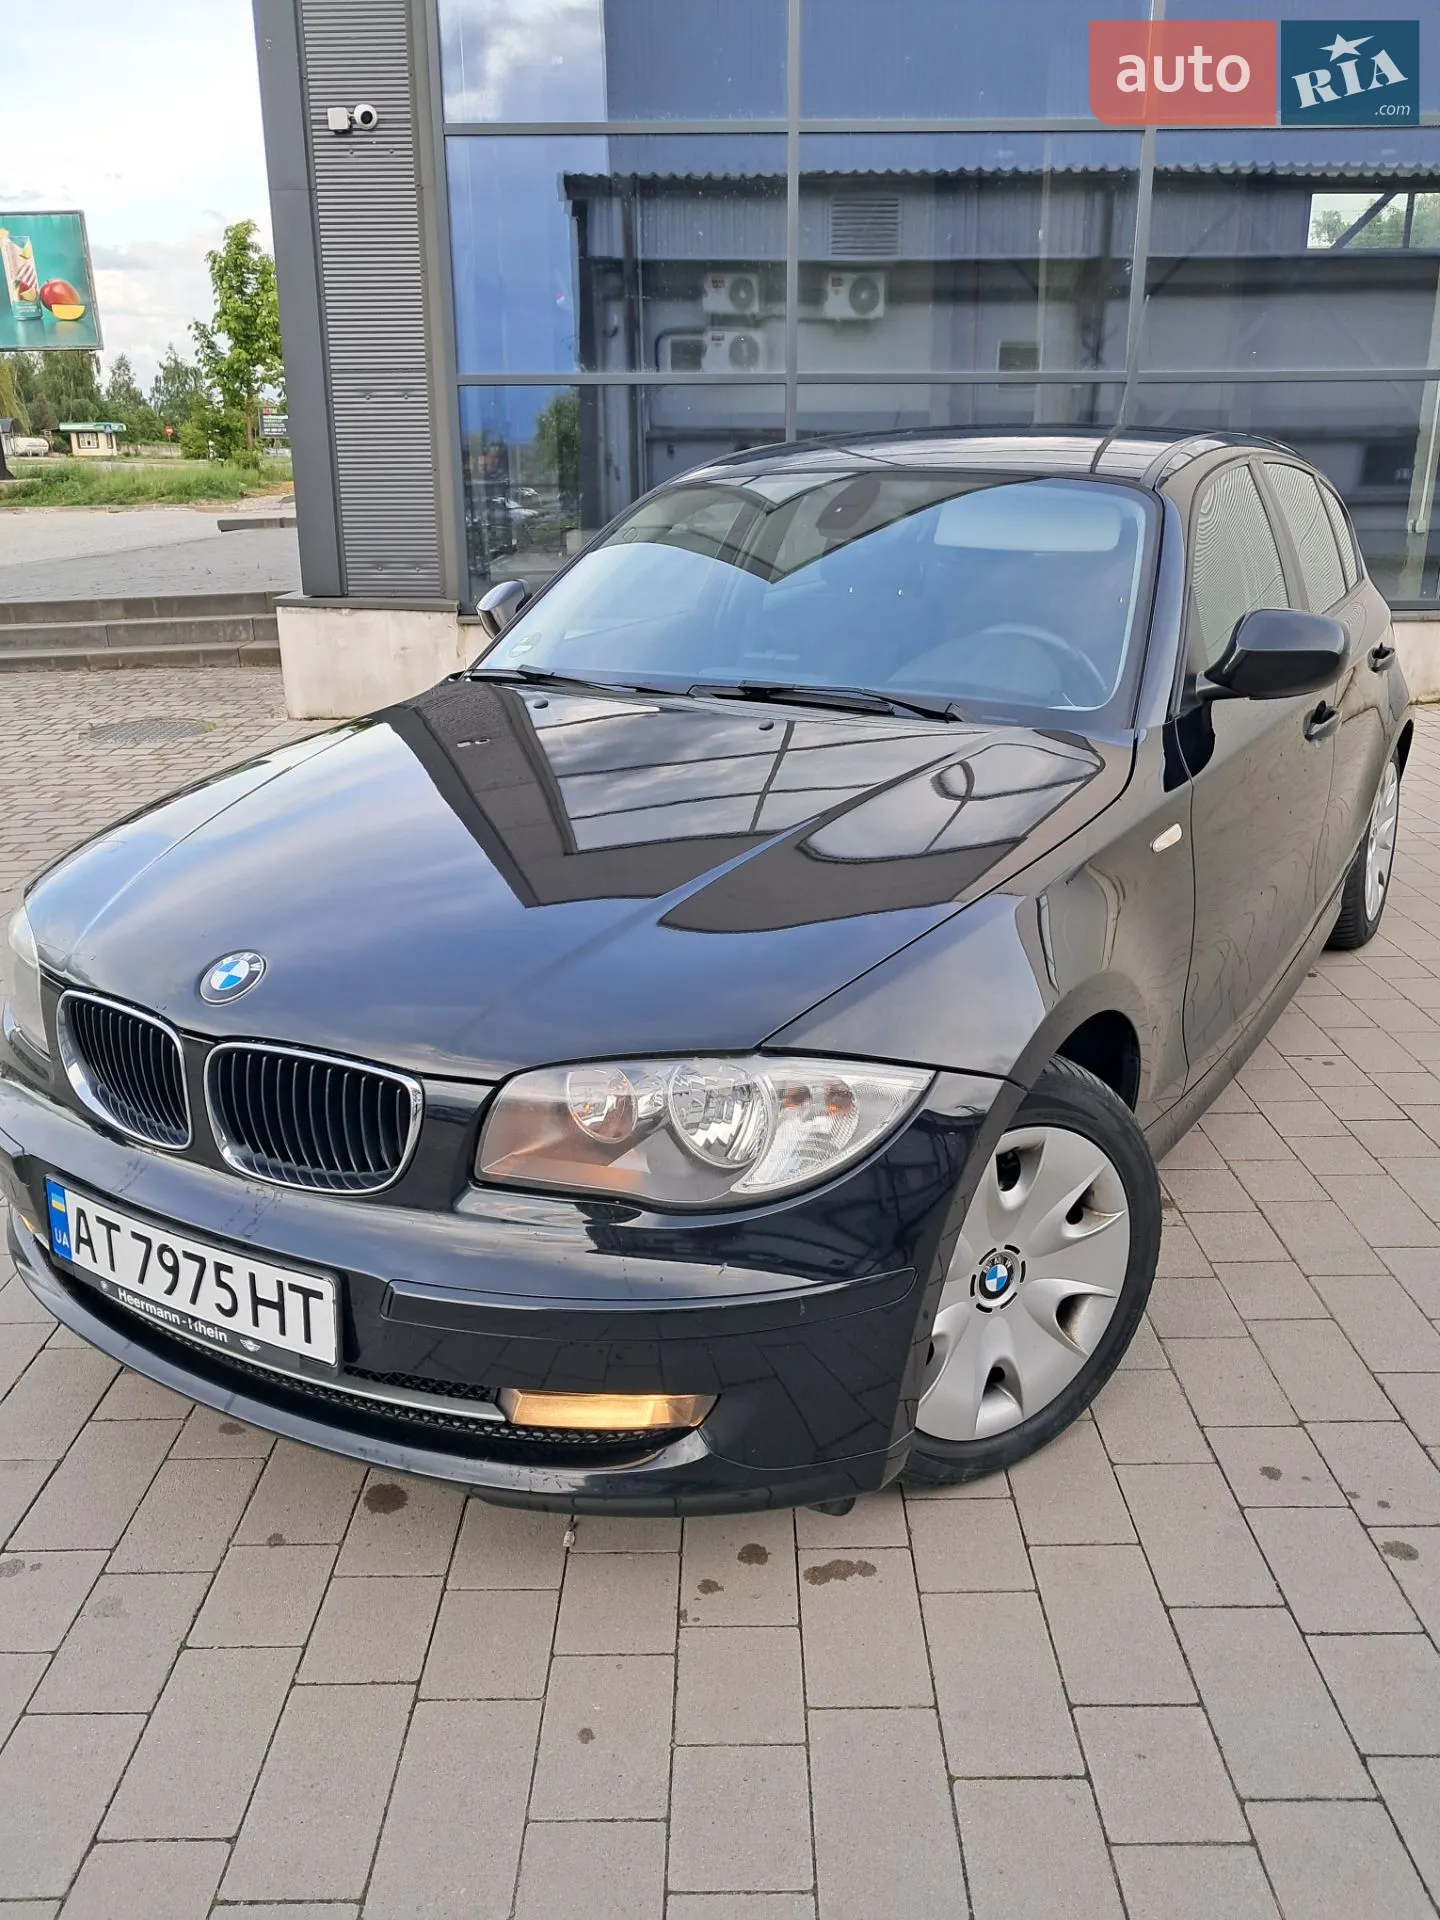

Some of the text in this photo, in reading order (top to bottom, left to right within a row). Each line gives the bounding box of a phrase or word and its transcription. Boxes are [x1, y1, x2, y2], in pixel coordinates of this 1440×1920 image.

[54, 1227, 70, 1249] UA
[74, 1207, 324, 1344] AT 7975 HT
